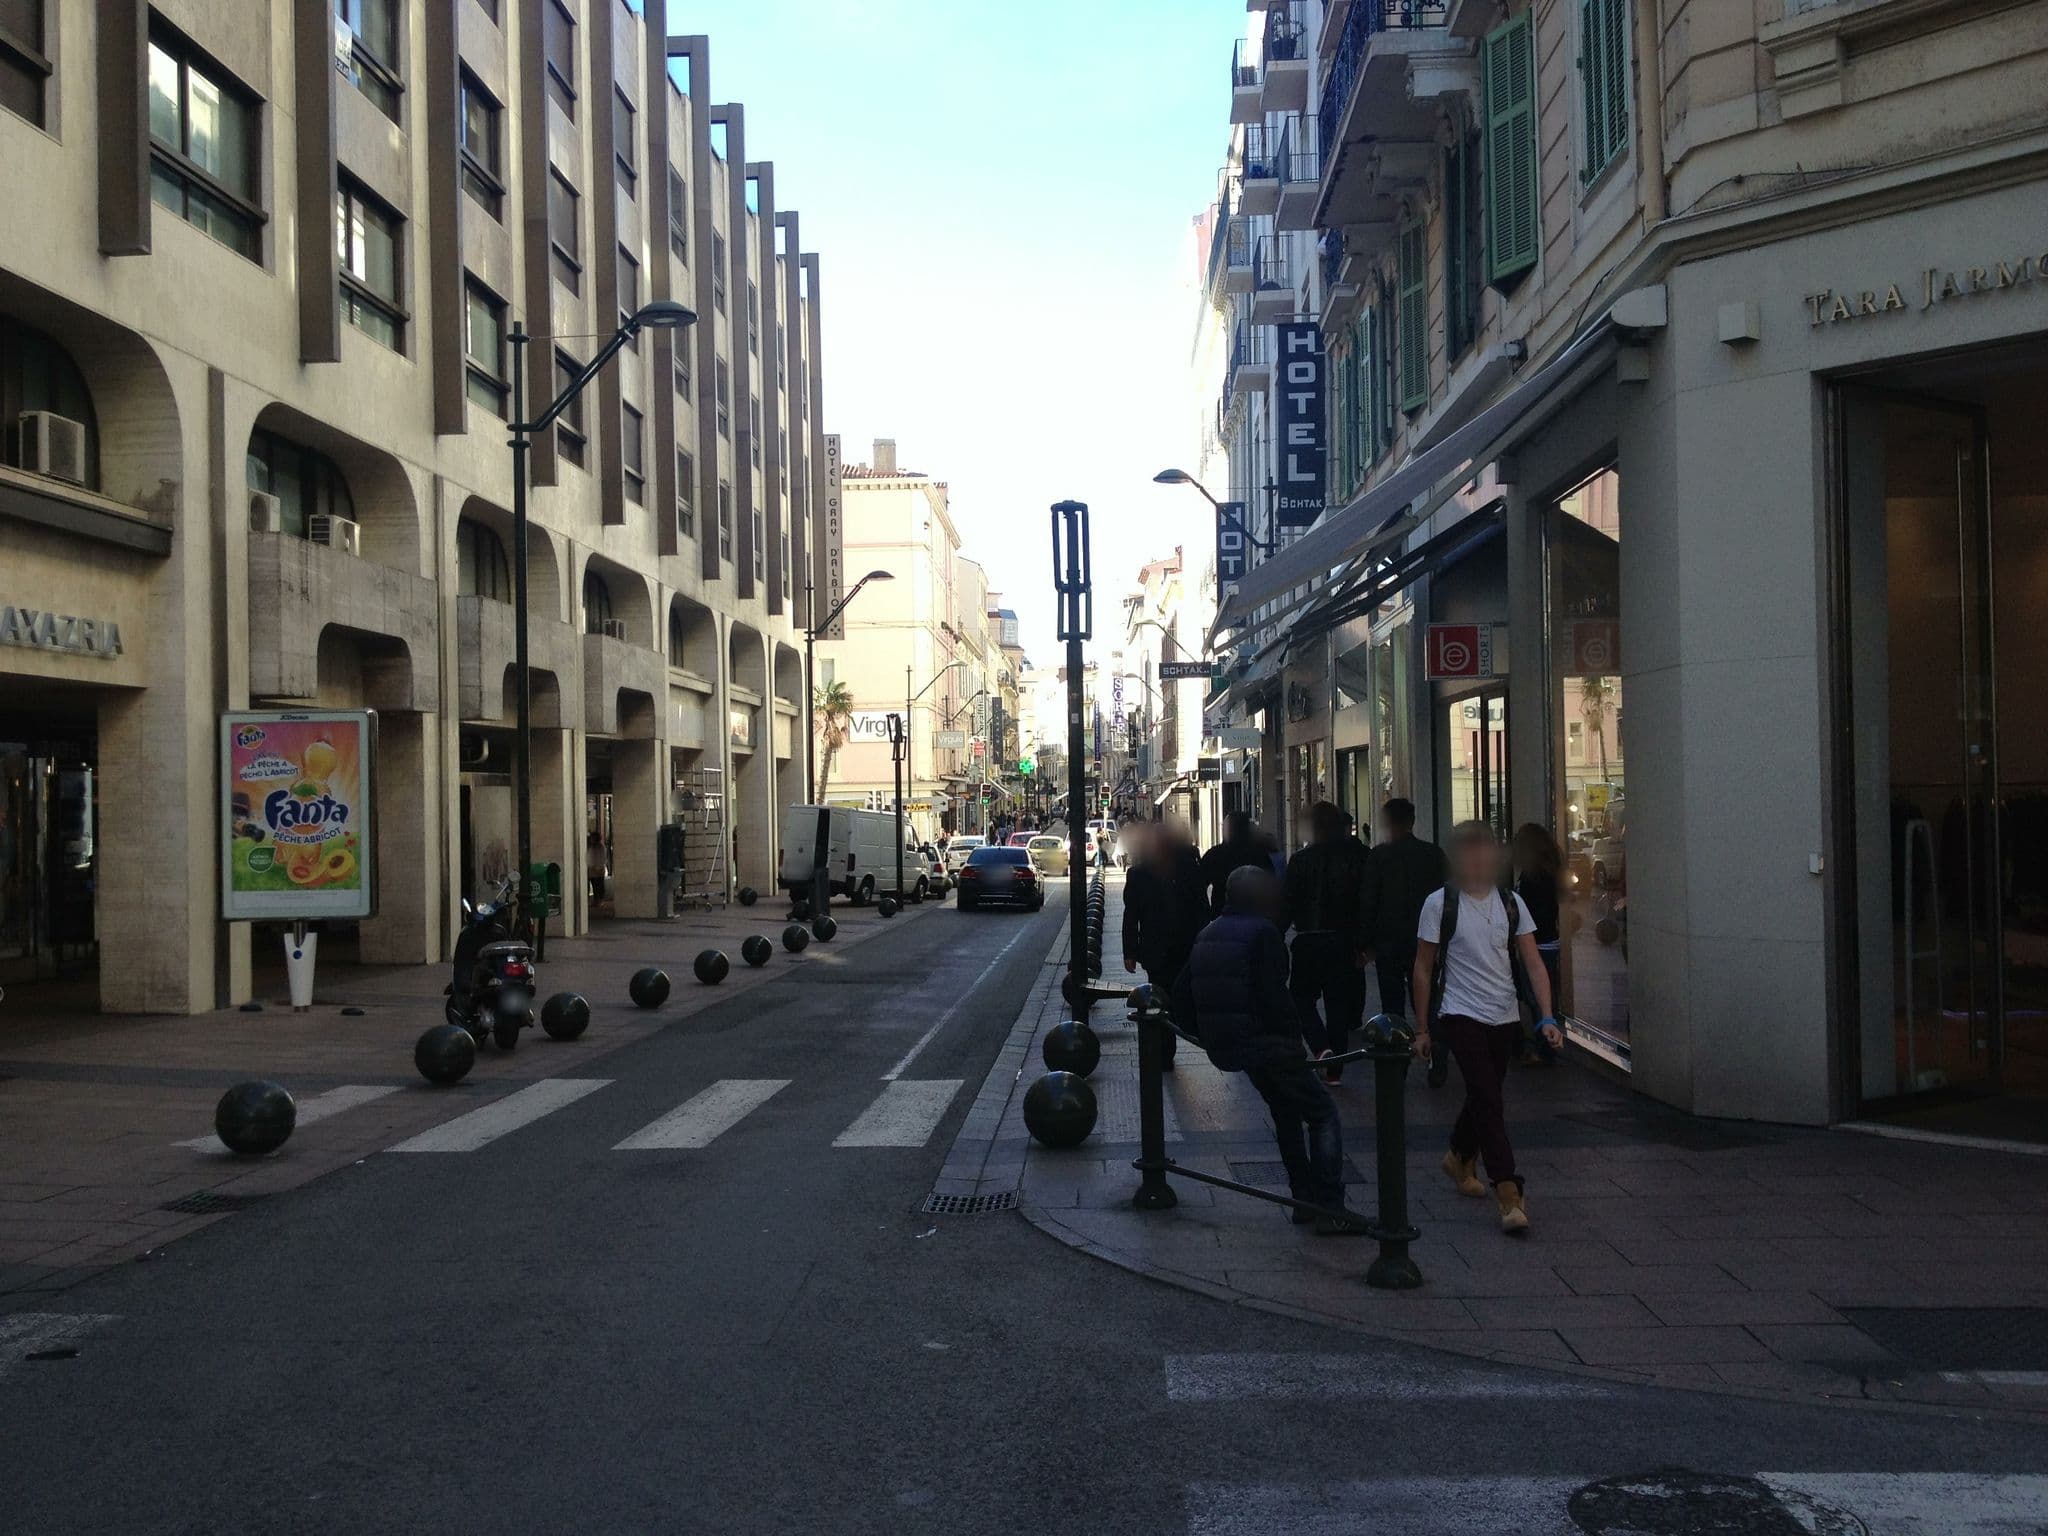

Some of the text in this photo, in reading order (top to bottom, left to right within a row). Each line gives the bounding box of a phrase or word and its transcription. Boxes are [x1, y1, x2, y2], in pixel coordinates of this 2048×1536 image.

[1805, 281, 1905, 328] TARA
[1287, 330, 1316, 482] HOTEL
[828, 437, 836, 487] HOTEL
[829, 498, 838, 537] GRAY
[1280, 497, 1322, 509] SCHTAK
[1480, 624, 1490, 676] SHORTS
[237, 730, 266, 747] Fanta
[850, 716, 912, 737] Virge
[265, 790, 348, 830] Fanta
[304, 827, 341, 844] ABRICOT
